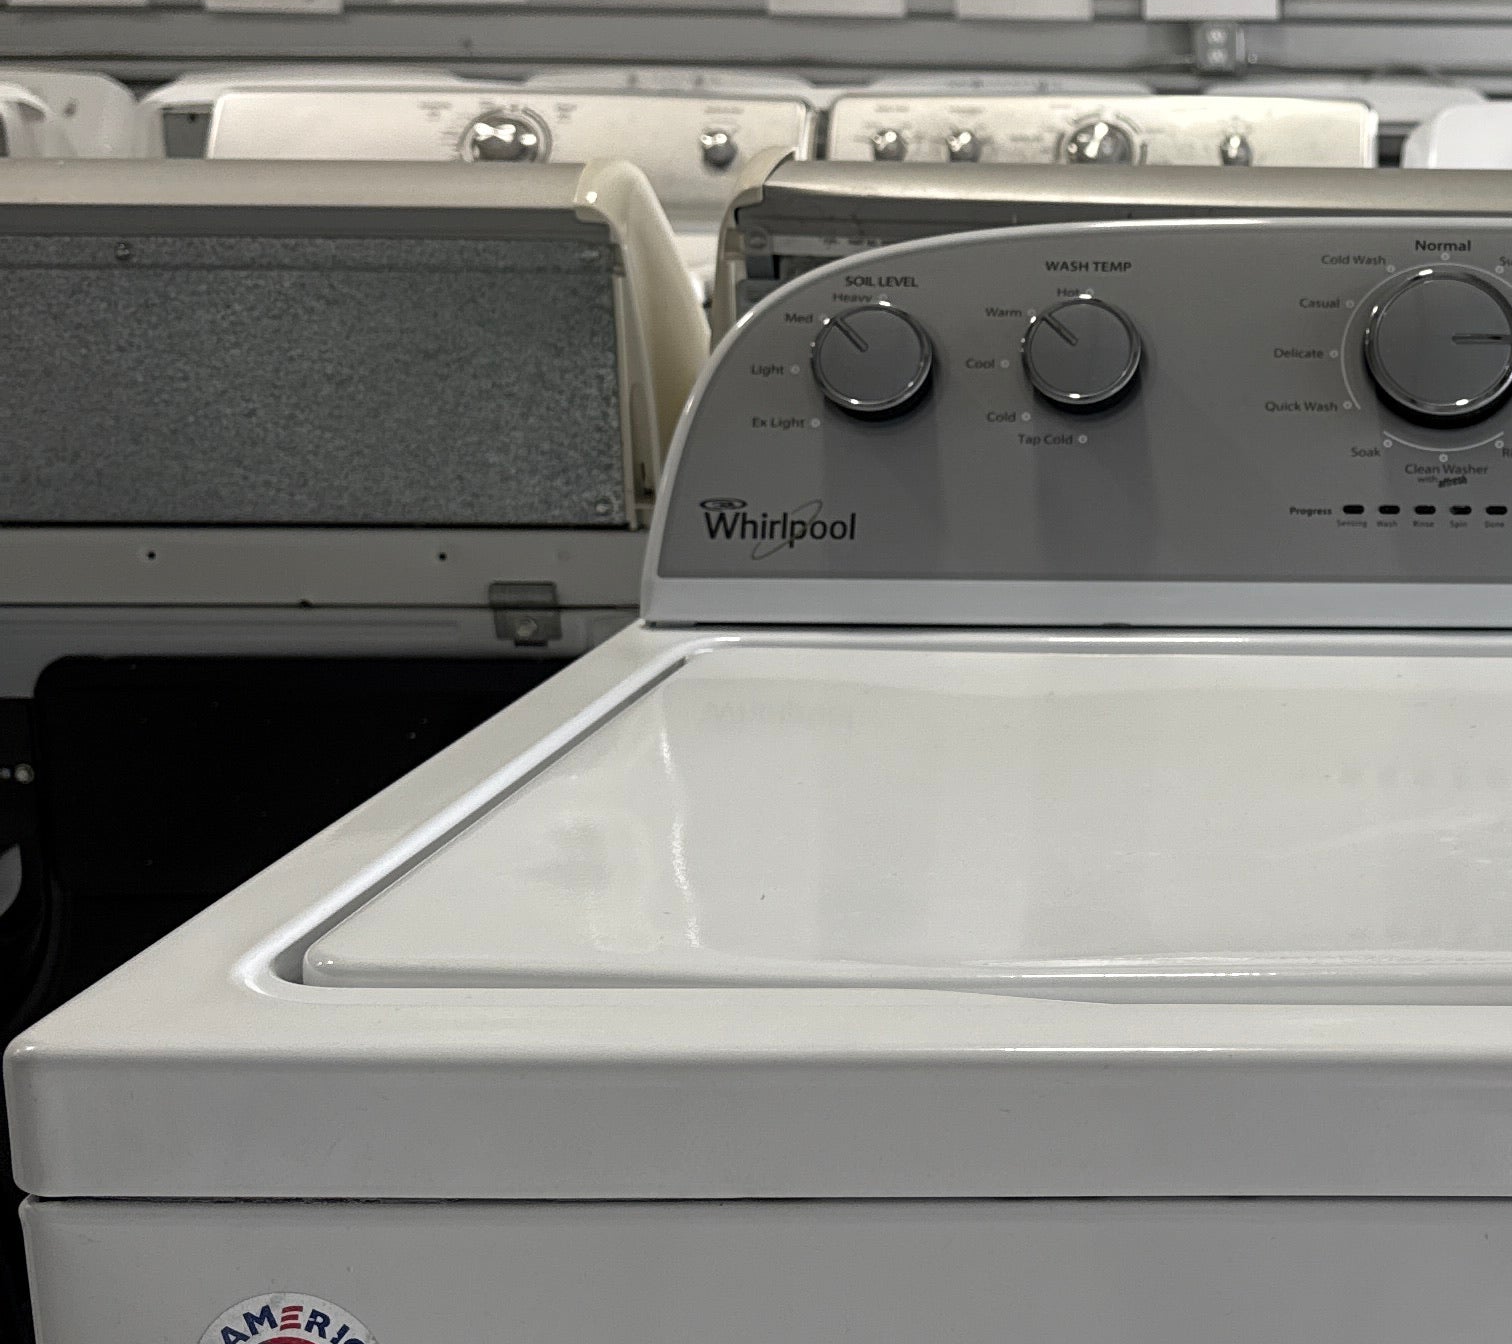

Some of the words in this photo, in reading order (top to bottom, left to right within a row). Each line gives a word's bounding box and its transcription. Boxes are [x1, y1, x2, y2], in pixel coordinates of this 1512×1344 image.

[1415, 240, 1471, 253] Normal
[1321, 254, 1350, 265] Cold
[1353, 254, 1386, 265] Wash
[1045, 261, 1087, 272] WASH
[1092, 261, 1132, 273] TEMP
[845, 276, 875, 287] SOIL
[878, 276, 919, 288] LEVEL
[1057, 287, 1080, 298] Hot
[833, 293, 873, 304] Heavy
[1300, 297, 1340, 309] Casual
[985, 307, 1022, 318] Warm
[785, 313, 813, 324] Med
[1274, 348, 1324, 359] Delicate
[965, 358, 995, 369] Cool
[751, 364, 785, 377] Light
[1265, 400, 1301, 413] Quick
[1305, 400, 1338, 412] Wash
[986, 411, 1016, 422] Cold
[752, 417, 769, 428] Ex
[772, 417, 805, 430] Light
[1018, 434, 1042, 447] Tap
[1045, 434, 1073, 445] Cold
[1351, 447, 1380, 458] Soak
[1405, 463, 1440, 475] Clean
[1443, 463, 1488, 475] Washer
[1417, 475, 1437, 484] with
[1290, 506, 1333, 518] Progress
[1413, 520, 1435, 528] Rinse
[1450, 520, 1468, 530] Spin
[704, 511, 857, 549] Whirlpool
